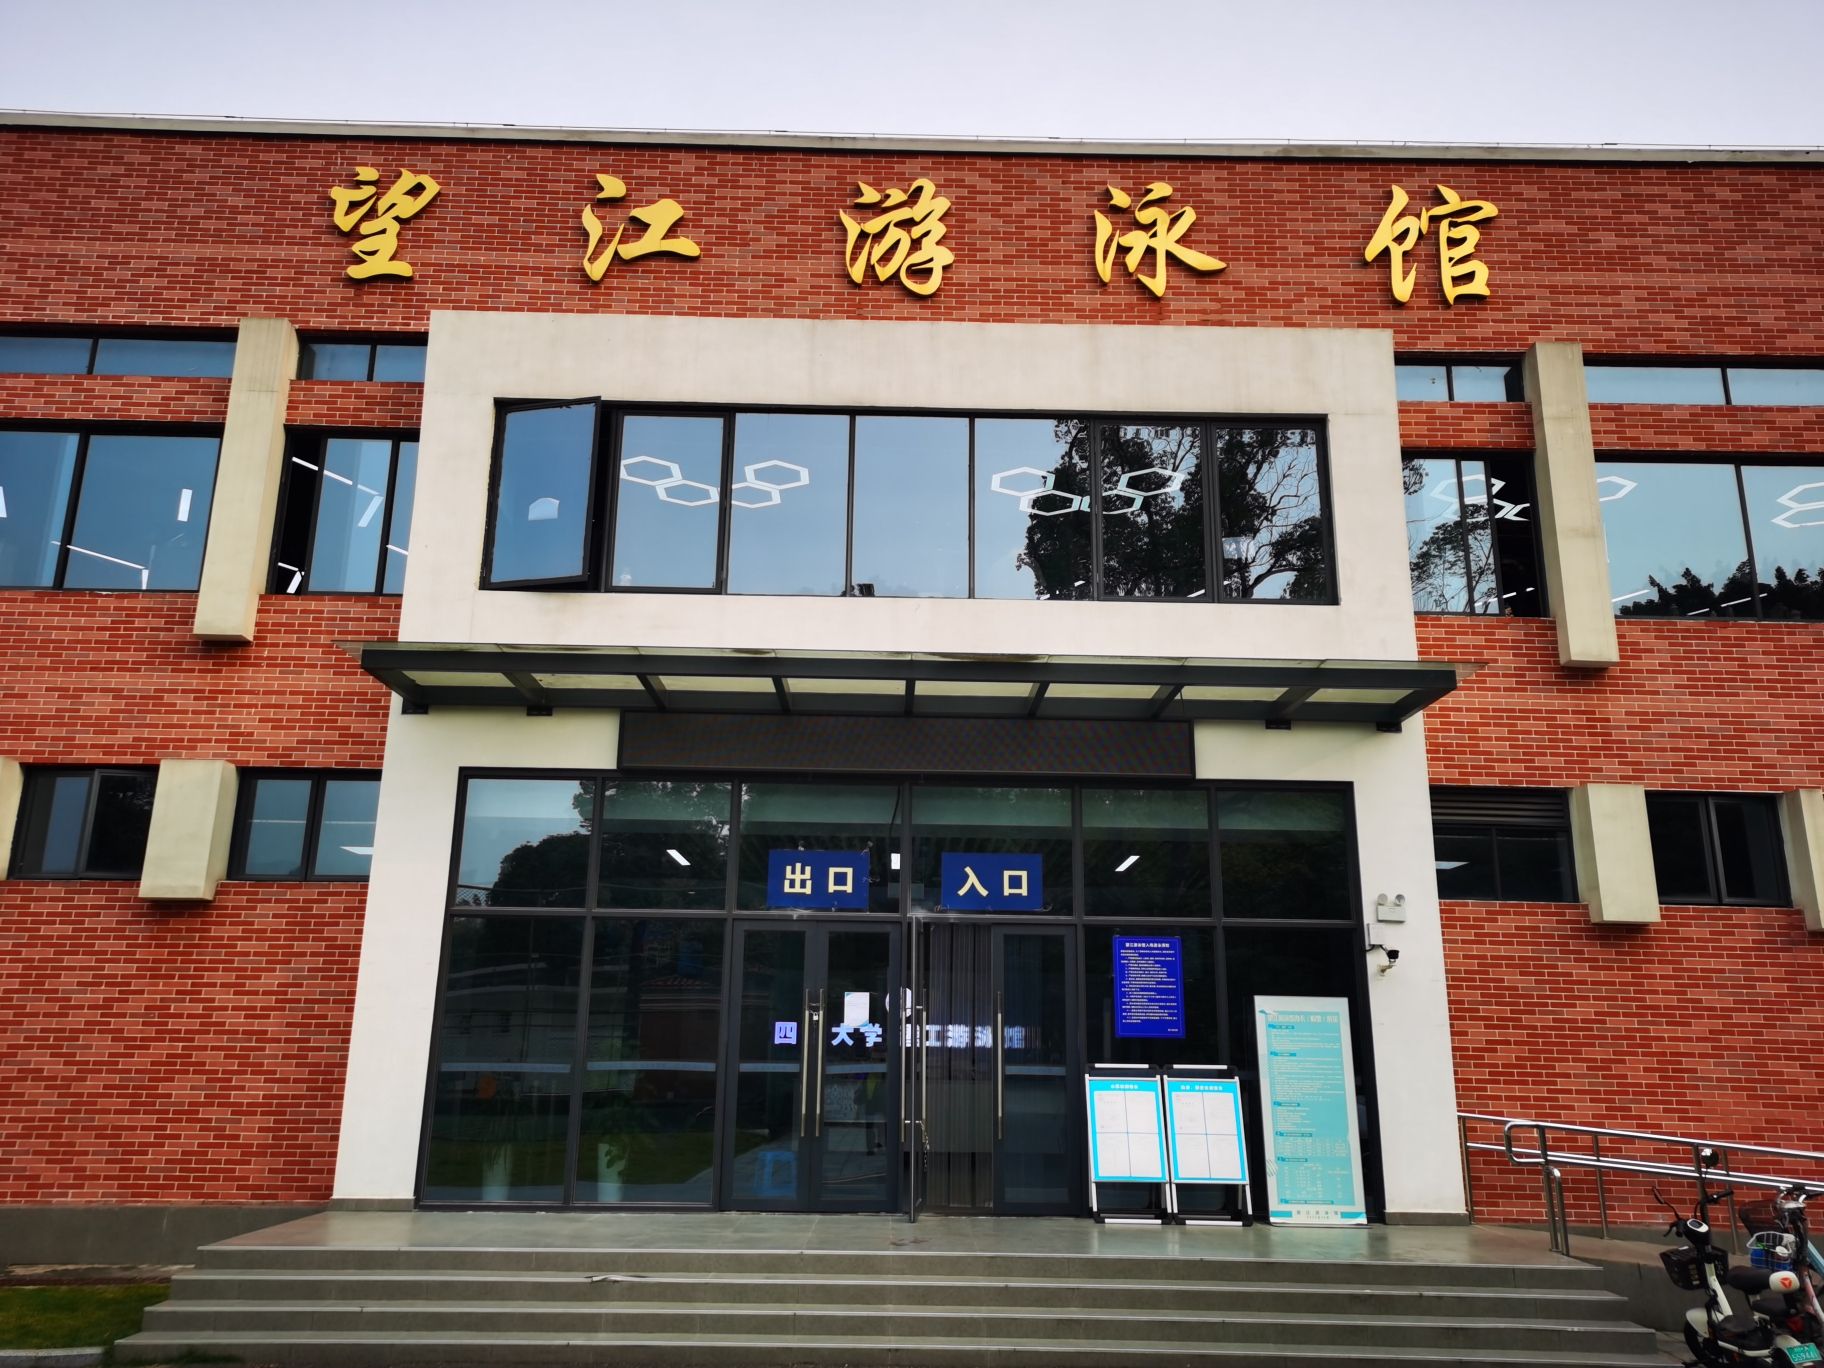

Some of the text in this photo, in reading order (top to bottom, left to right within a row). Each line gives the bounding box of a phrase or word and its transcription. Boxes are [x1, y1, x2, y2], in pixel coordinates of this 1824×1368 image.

[329, 166, 1499, 305] 望江游泳馆
[783, 862, 854, 895] 出口
[957, 865, 1029, 897] 入口
